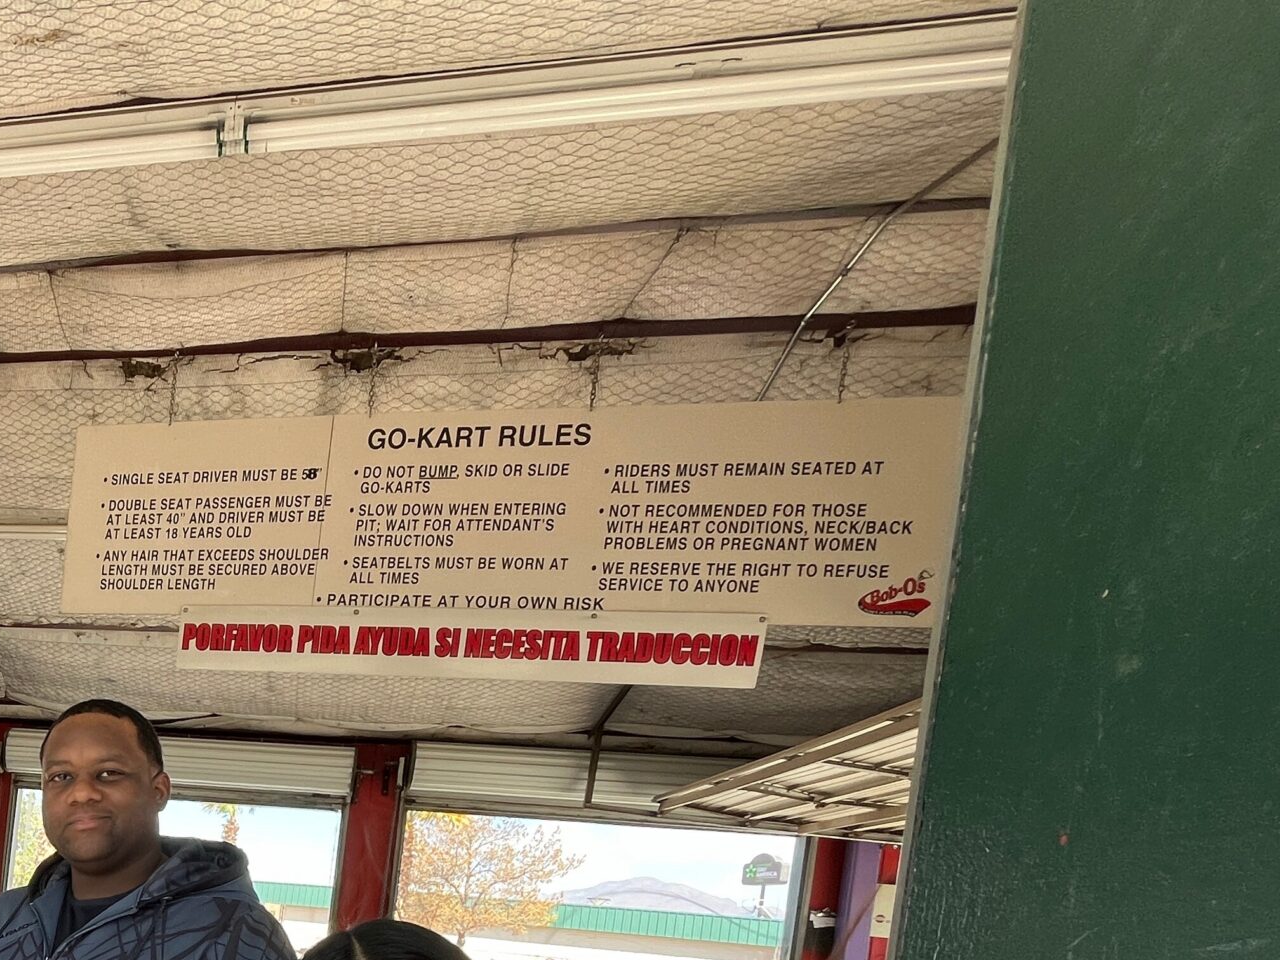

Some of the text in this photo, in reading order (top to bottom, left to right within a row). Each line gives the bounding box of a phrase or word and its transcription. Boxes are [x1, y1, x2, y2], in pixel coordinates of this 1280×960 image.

[368, 423, 591, 449] GO-KART RULES
[363, 463, 570, 480] DO NOT BUMP, SKID OR SLIDE
[615, 461, 884, 477] RIDERS MUST REMAIN SEATED AT
[111, 473, 154, 485] SINGLE
[158, 472, 189, 484] SEAT
[193, 470, 237, 483] DRIVER
[242, 469, 277, 482] MUST
[281, 469, 297, 480] BE
[361, 481, 430, 494] GO-KARTS
[611, 480, 691, 494] ALL TIMES
[109, 493, 332, 511] DOUBLE SEAT PASSENGER MUST BE
[359, 502, 566, 516] SLOW DOWN WHEN ENTERING
[106, 509, 325, 525] AT LEAST 40" AND DRIVER MUST BE
[609, 503, 867, 518] NOT RECOMMENDED FOR THOSE
[105, 526, 251, 539] AT LEAST 18 YEARS OLD
[356, 518, 554, 533] PIT; WAIT FOR ATTENDANT'S
[607, 520, 913, 536] WITH HEART CONDITIONS, NECK/BACK
[354, 534, 453, 547] INSTRUCTIONS
[604, 537, 877, 551] PROBLEMS OR PREGNANT WOMEN
[103, 547, 329, 562] ANY HAIR THAT EXCEEDS SHOULDER
[102, 562, 316, 576] LENGTH MUST BE SECURED ABOVE
[352, 557, 569, 570] SEATBELTS MUST BE WORN AT
[603, 562, 890, 578] WE RESERVE THE RIGHT TO REFUSE
[100, 578, 215, 590] SHOULDER LENGTH
[349, 572, 419, 584] ALL TIMES
[598, 578, 760, 593] SERVICE TO ANYONE
[327, 594, 606, 611] PARTICIPATE AT YOUR OWN RISK
[182, 623, 759, 666] PORFAVOR PIDA AYUDA SI NECESITA TRADUCCION
